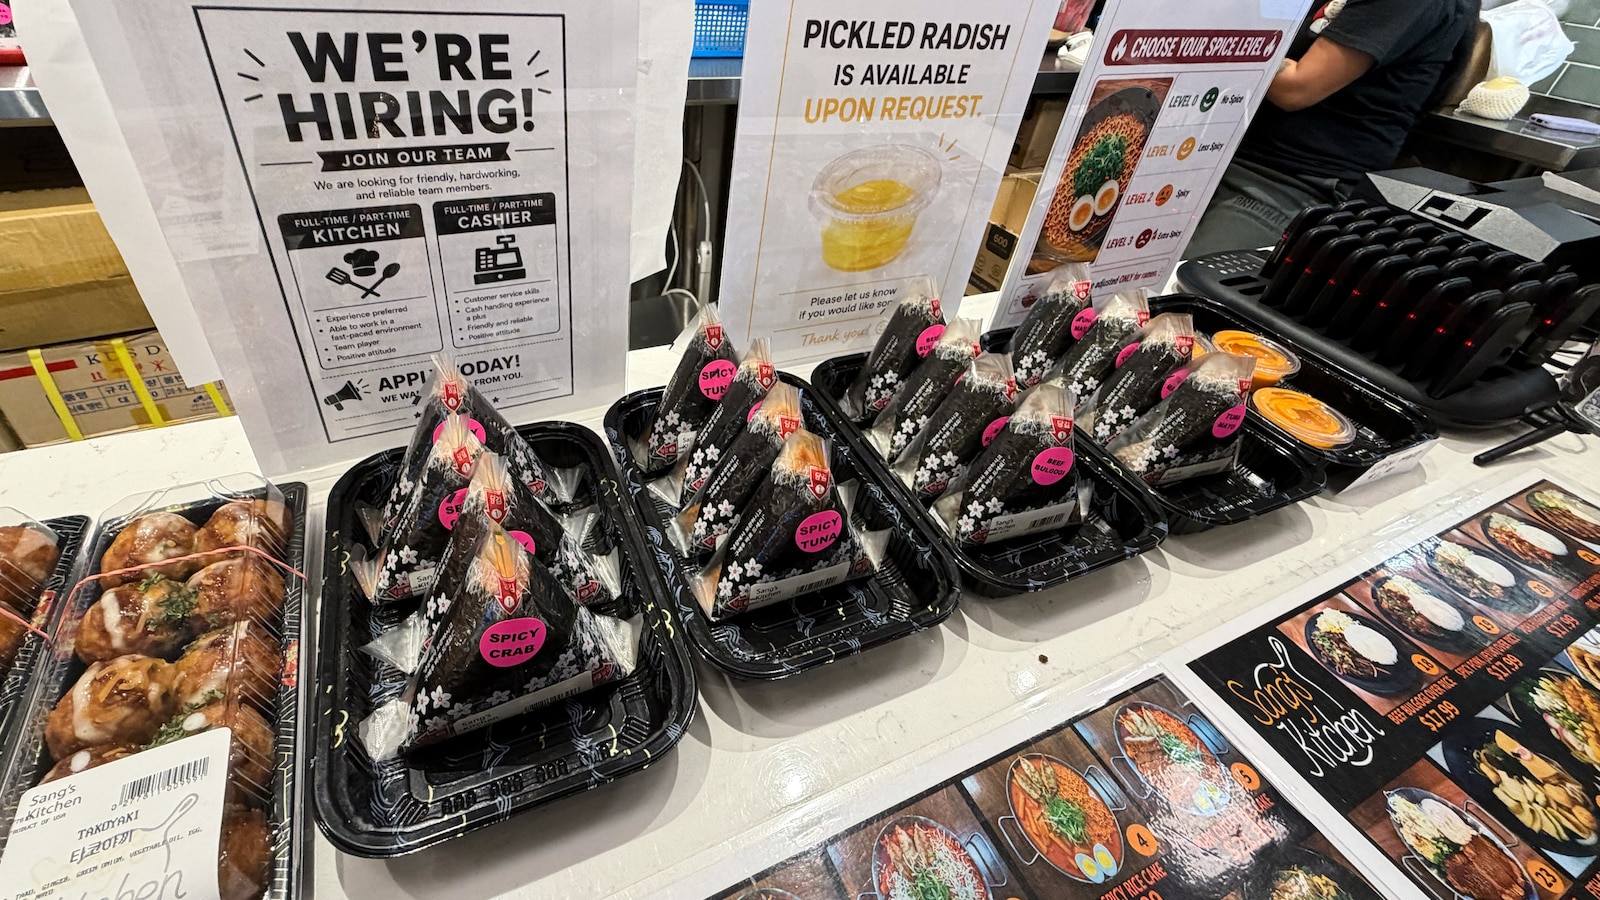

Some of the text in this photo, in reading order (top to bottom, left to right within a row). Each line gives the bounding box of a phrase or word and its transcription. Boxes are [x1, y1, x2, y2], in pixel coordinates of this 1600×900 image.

[804, 20, 1011, 50] PICKLED RADISH
[1130, 36, 1266, 58] CHOOSE YOUR SPICE LEVEL
[834, 64, 970, 86] IS AVAILABLE
[804, 95, 983, 124] UPON REQUEST.
[1168, 94, 1244, 108] LEVEL 0 No Spice
[278, 88, 534, 142] HIRING!
[342, 146, 492, 167] JOIN OUR TEAM
[1146, 142, 1224, 158] LEVEL 1 Less Spicy
[314, 168, 521, 191] We are looking for friendly, hardworking,
[356, 182, 492, 200] and reliable team members.
[1125, 188, 1190, 206] LEVEL 2 Spicy
[444, 203, 491, 215] FULL-TIME
[499, 198, 543, 210] PART-TIME
[294, 216, 349, 228] FULL-TIME
[360, 210, 411, 222] PART-TIME
[458, 210, 532, 230] CASHIER
[312, 222, 400, 244] KITCHEN
[994, 234, 1008, 248] 600
[1106, 237, 1127, 249] LEVEL
[1127, 236, 1134, 246] 3
[1169, 230, 1182, 238] Spicy
[1095, 277, 1119, 290] adjusted
[1119, 275, 1134, 284] ONLY
[464, 294, 497, 304] Customer
[500, 290, 522, 299] service
[484, 300, 513, 312] handling
[514, 296, 550, 307] experience
[810, 296, 842, 306] Please
[844, 293, 857, 302] let
[872, 288, 898, 298] know
[326, 306, 408, 322] Experience preferred
[473, 313, 486, 322] plus
[799, 301, 874, 320] if you would like
[330, 324, 347, 333] Able
[360, 319, 378, 328] work
[332, 322, 422, 341] fast-paced environment
[468, 321, 494, 332] Friendly
[510, 315, 533, 324] reliable
[468, 327, 520, 340] Positive attitude
[802, 324, 872, 346] Thank you!
[334, 340, 380, 350] Team player
[337, 346, 396, 360] Positive attitude
[457, 354, 520, 376] ODAY!
[702, 368, 734, 380] SPICY
[381, 372, 524, 403] WE FROM YOU.
[704, 385, 727, 396] TUN
[1034, 464, 1066, 476] BULGOGI
[1047, 458, 1065, 467] BEEF
[800, 518, 839, 536] SPICY
[801, 532, 838, 549] TUNA
[757, 586, 778, 594] Sang's
[1534, 584, 1549, 594] 20
[1479, 619, 1495, 630] 19
[1546, 614, 1580, 638] $17.99
[490, 628, 541, 643] SPICY
[489, 644, 535, 659] CRAB
[1417, 658, 1434, 671] 18
[1454, 664, 1476, 679] SPICY
[1486, 654, 1524, 681] $17.99
[1227, 664, 1317, 726] Sang's
[1387, 675, 1458, 725] BEEF BULGOGI OVER RICE
[1418, 700, 1460, 733] $17.99
[1277, 704, 1385, 777] Kitchen
[1242, 769, 1252, 784] 5
[30, 784, 76, 807] Sang's
[1250, 791, 1274, 814] CAKE
[26, 795, 82, 821] Kitchen
[53, 813, 66, 821] USA
[77, 810, 140, 840] TAKOYAKI
[1137, 832, 1149, 848] 4
[76, 865, 98, 878] GREEN
[130, 841, 167, 858] VEGETABLE
[1123, 874, 1148, 898] RICE
[1141, 861, 1168, 885] CAKE
[1535, 868, 1557, 888] 23
